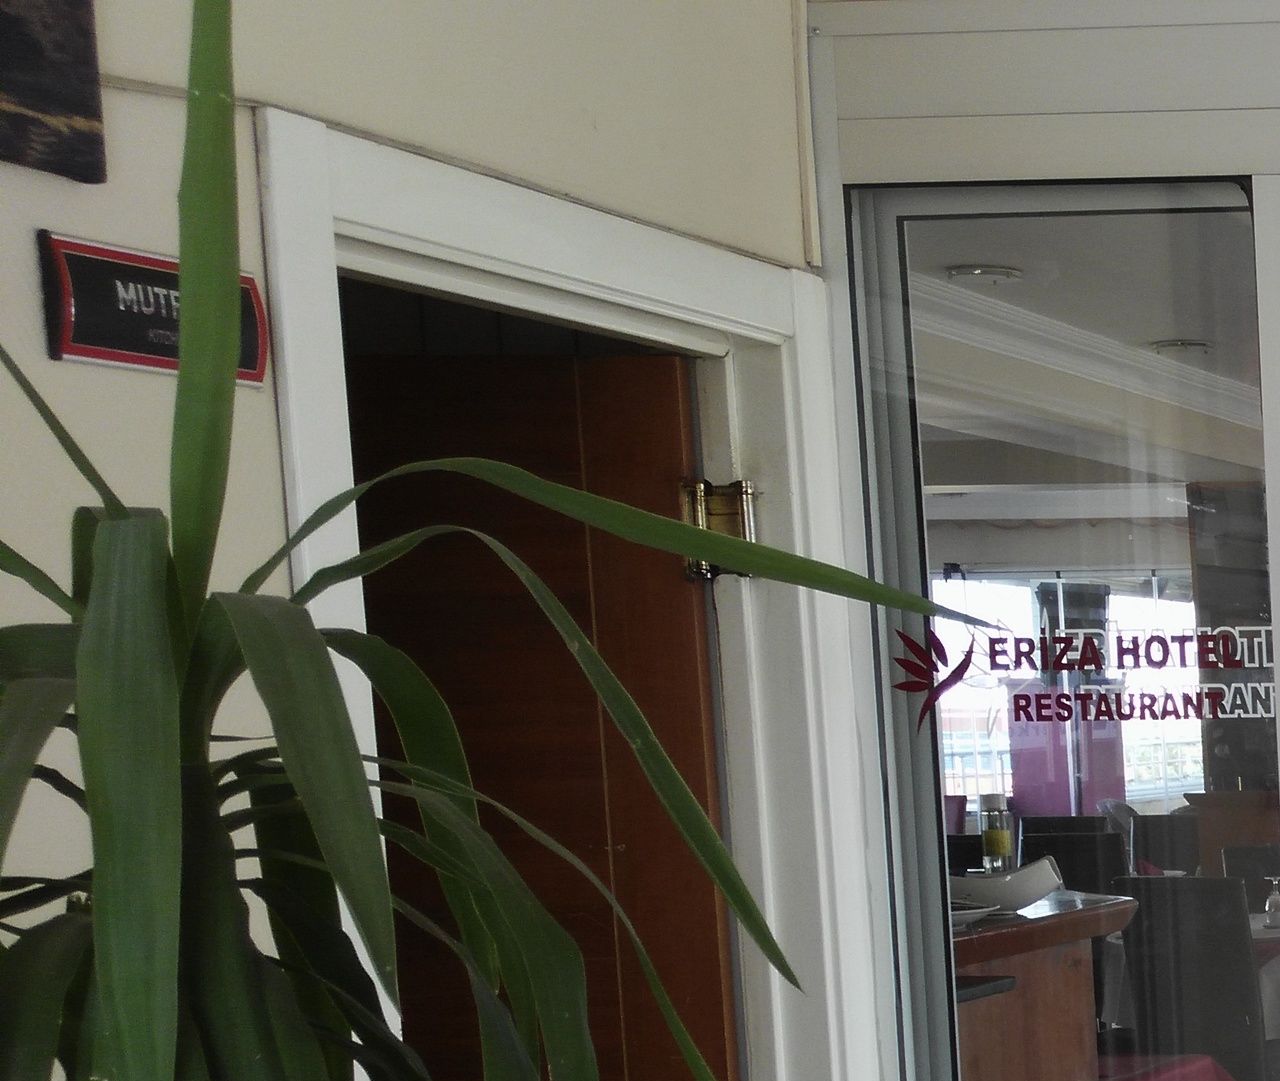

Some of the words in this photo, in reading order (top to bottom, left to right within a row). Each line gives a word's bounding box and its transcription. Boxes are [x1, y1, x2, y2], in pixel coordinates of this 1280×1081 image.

[988, 627, 1103, 672] ERİZA
[1116, 634, 1243, 670] HOTEL
[1013, 692, 1227, 722] RESTAURANT
